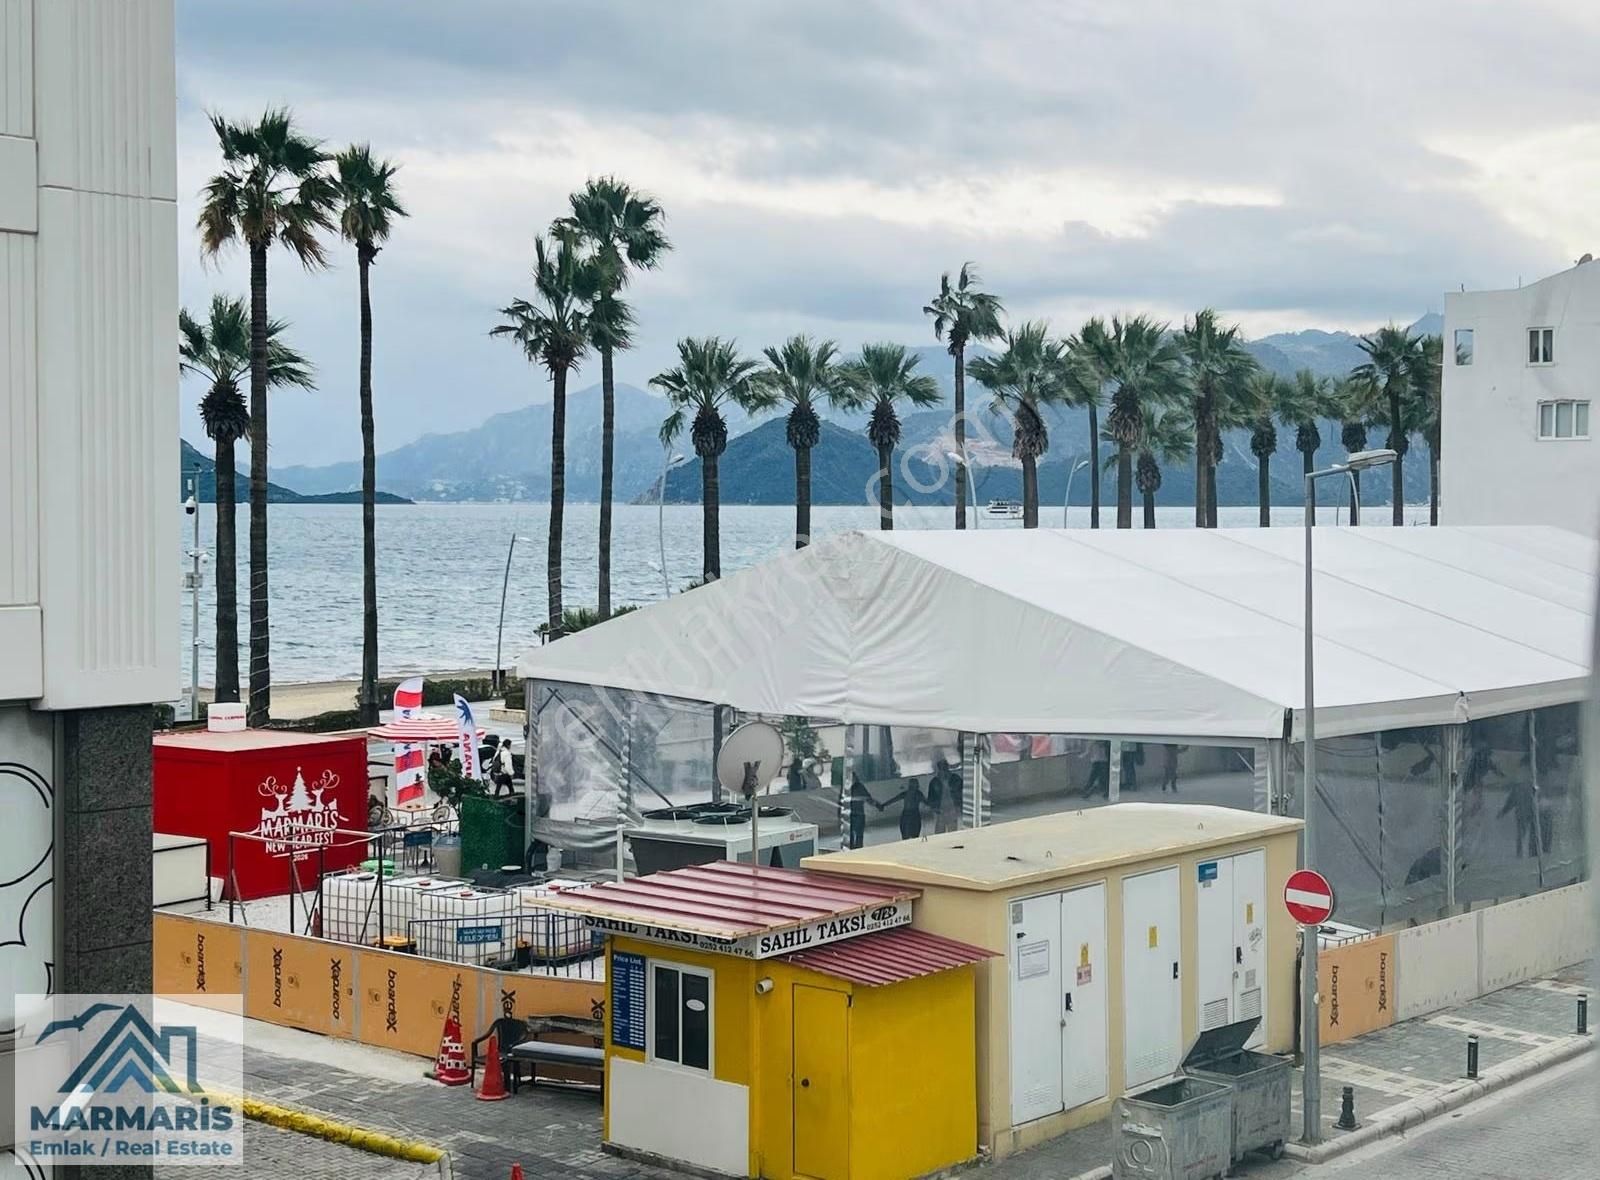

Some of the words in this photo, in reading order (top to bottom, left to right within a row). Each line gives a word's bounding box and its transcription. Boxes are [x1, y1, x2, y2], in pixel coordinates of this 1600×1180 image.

[867, 921, 881, 931] 0252
[883, 918, 893, 927] 412
[895, 916, 902, 924] 47
[700, 941, 717, 951] 0252
[719, 945, 732, 953] 412
[734, 947, 743, 956] 47
[744, 949, 754, 958] 66
